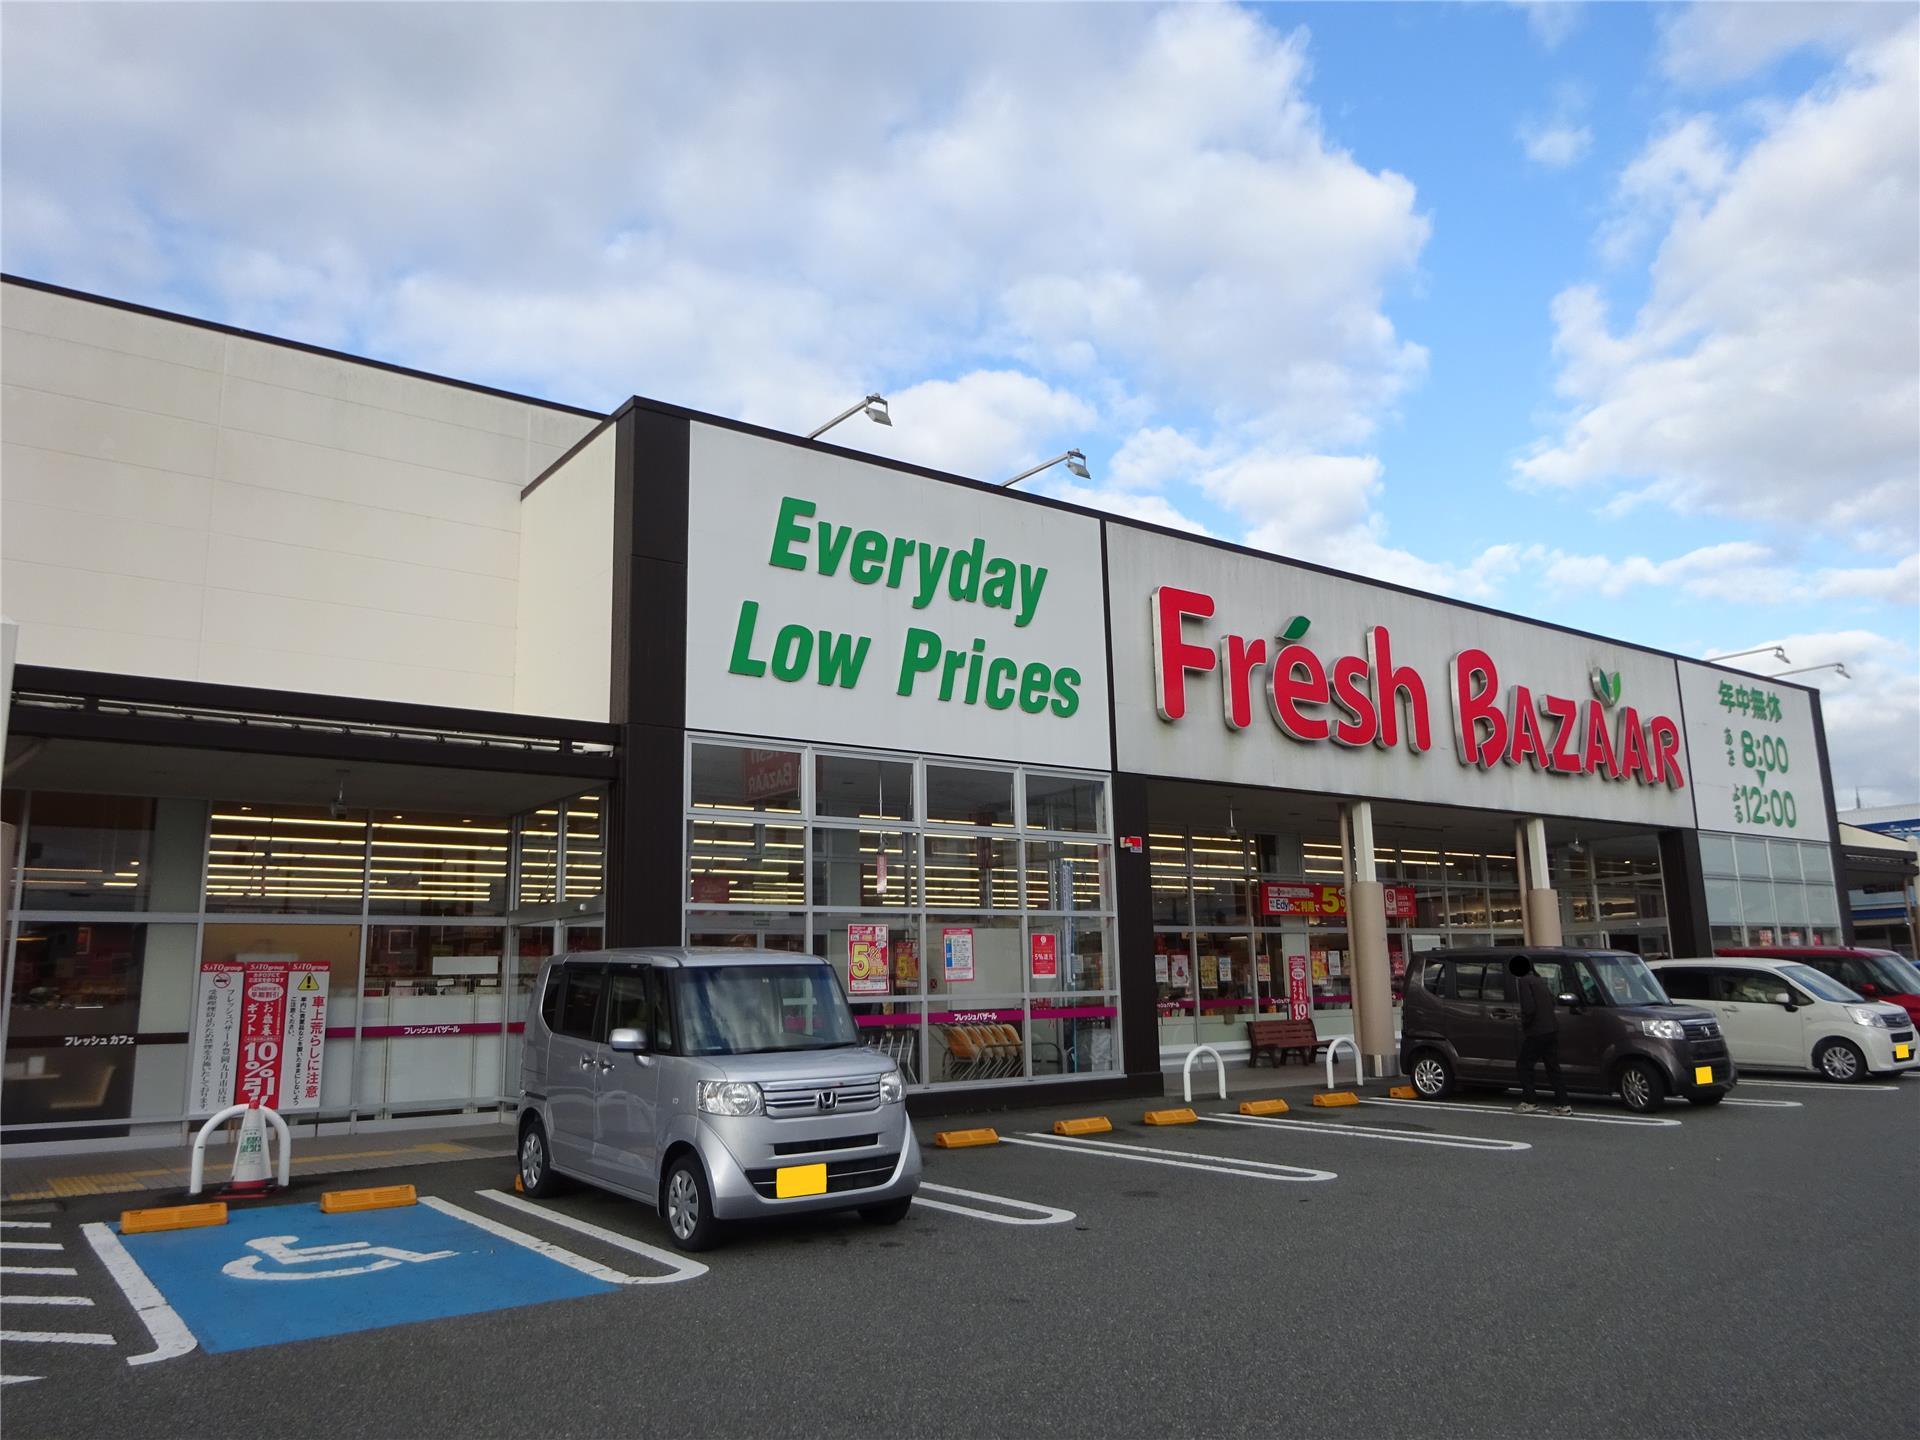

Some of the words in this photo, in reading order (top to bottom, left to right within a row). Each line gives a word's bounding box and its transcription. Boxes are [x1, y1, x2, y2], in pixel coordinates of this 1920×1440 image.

[769, 496, 1048, 627] Everyday
[728, 600, 872, 689] Low
[896, 627, 1082, 718] Prices
[1449, 649, 1685, 791] BAZAAR
[1718, 680, 1783, 723] 年中無休
[1724, 727, 1735, 767] あさ
[1741, 730, 1789, 774] 8:00
[1732, 783, 1743, 824] よる
[1741, 785, 1797, 828] 12:00
[247, 1003, 259, 1035] ギフト
[404, 1025, 460, 1035] フレッシュバザール
[954, 1012, 998, 1021] フレッシュバザール
[64, 1035, 108, 1046] フレッシュ
[109, 1034, 135, 1045] カフェ
[305, 996, 325, 1099] 車上荒らしに注意
